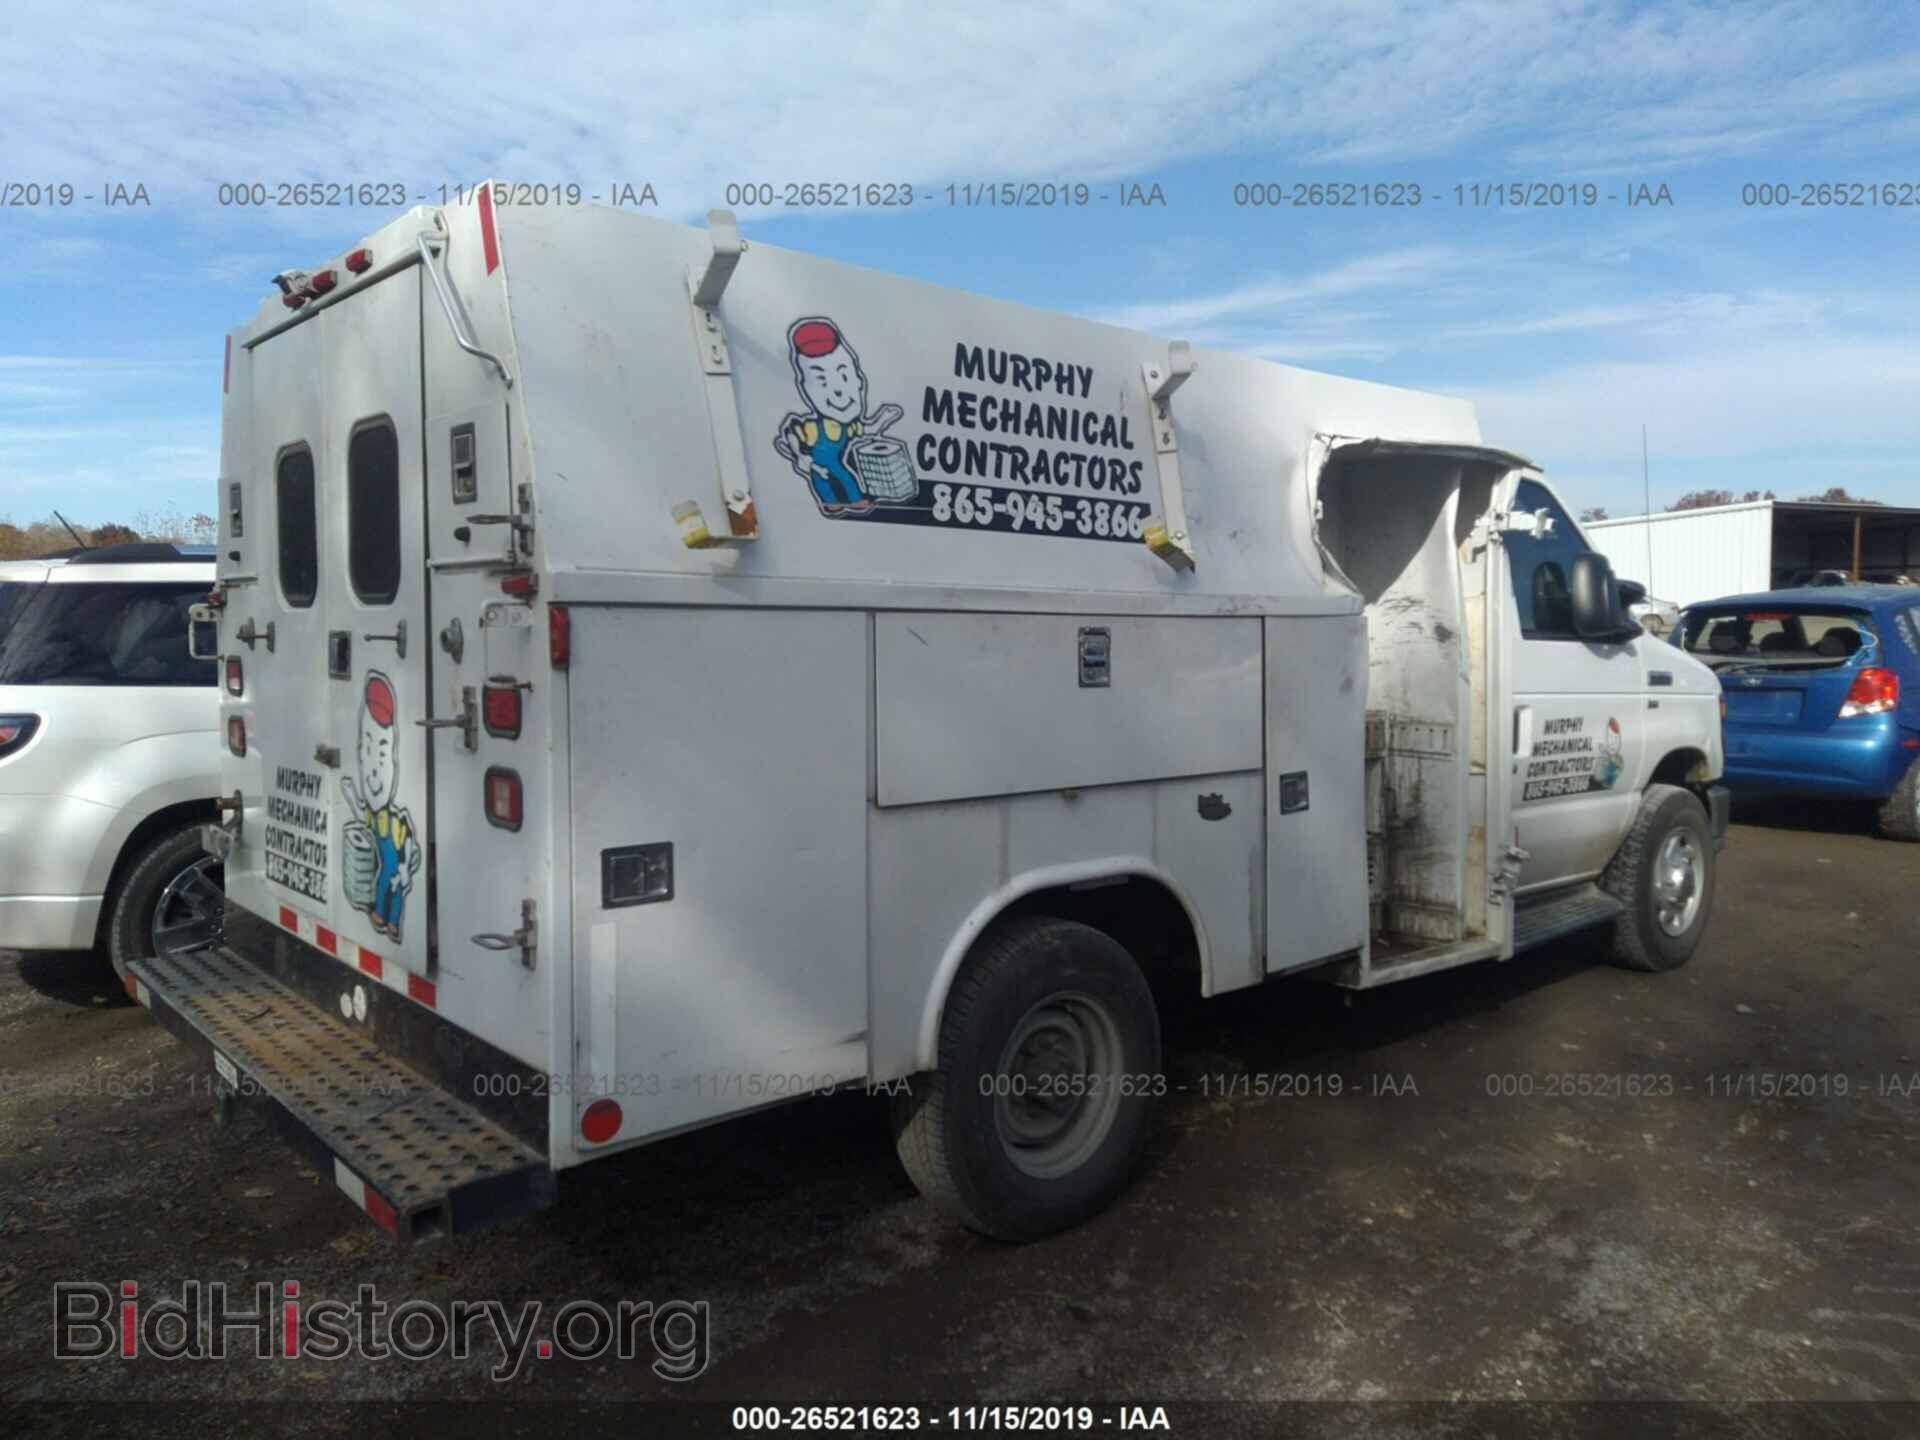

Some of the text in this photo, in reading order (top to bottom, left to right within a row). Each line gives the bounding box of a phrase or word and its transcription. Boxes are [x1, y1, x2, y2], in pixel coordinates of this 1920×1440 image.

[954, 342, 1094, 399] MURPHY
[922, 386, 1135, 450] MECHANICAL
[916, 433, 1143, 496] CONTRACTORS
[931, 483, 1144, 540] 865-945-3866
[1532, 737, 1593, 757] MECHANICAL
[1544, 717, 1584, 734] MURPHY
[276, 766, 322, 799] MURPHY
